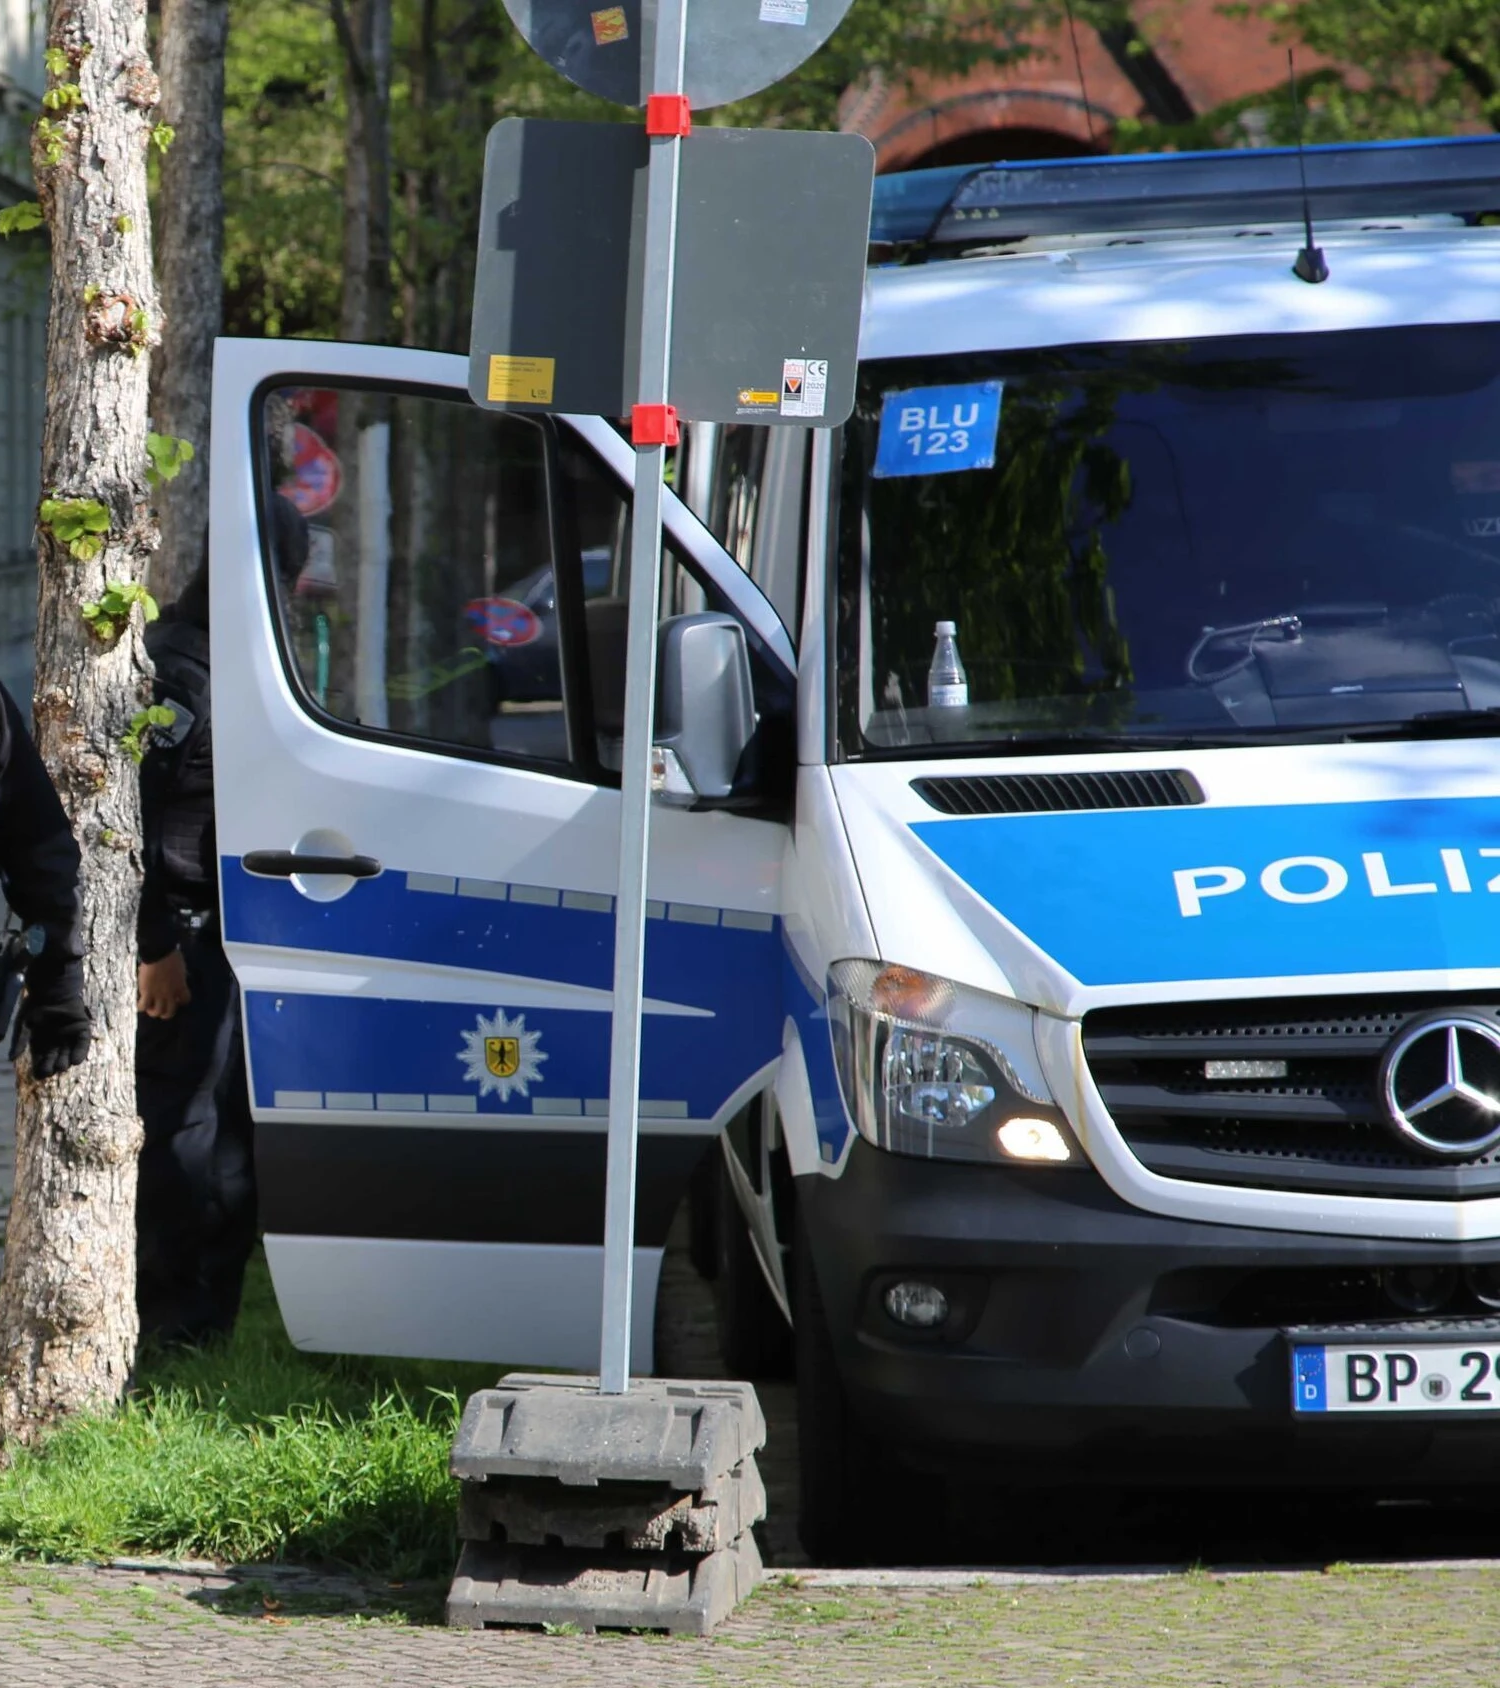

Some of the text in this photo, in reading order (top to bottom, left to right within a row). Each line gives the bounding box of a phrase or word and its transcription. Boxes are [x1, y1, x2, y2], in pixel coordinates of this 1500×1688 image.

[899, 403, 980, 432] BLU
[906, 430, 970, 456] 123
[1347, 1351, 1500, 1403] BP 2
[1304, 1384, 1318, 1400] D
